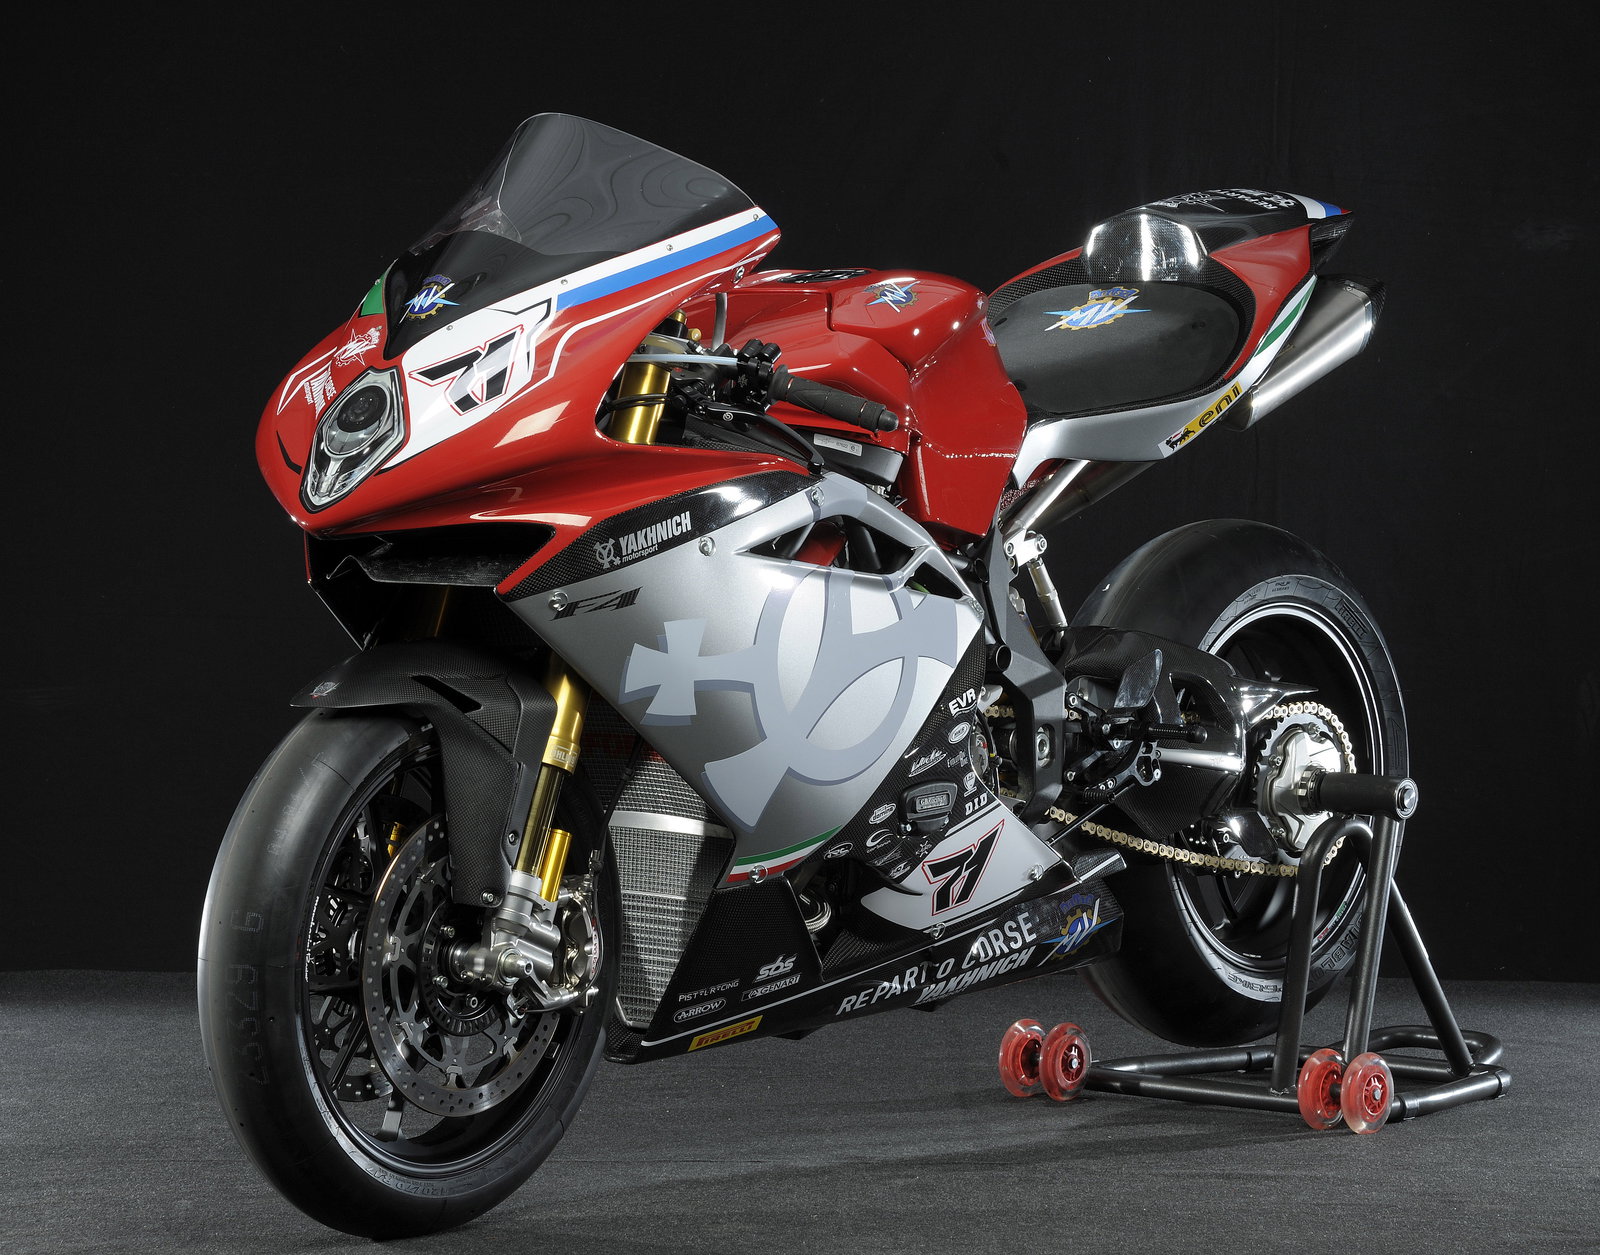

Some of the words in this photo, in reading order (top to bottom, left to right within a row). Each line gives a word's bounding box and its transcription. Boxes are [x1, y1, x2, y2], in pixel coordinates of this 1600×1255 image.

[399, 283, 456, 324] MV
[1199, 384, 1240, 428] eni
[619, 511, 692, 556] YAKHNICH
[622, 544, 659, 563] motorsport
[1335, 599, 1369, 639] PIRELLI
[948, 688, 976, 716] EVR
[923, 820, 1003, 915] 71
[1038, 899, 1100, 967] MV
[756, 954, 797, 980] sbs
[836, 957, 953, 1016] REPARTO
[961, 912, 1037, 969] CORSE
[916, 946, 1036, 1001] YAKHNICH
[677, 1000, 723, 1020] ARROW
[695, 1020, 756, 1047] PIRELLI
